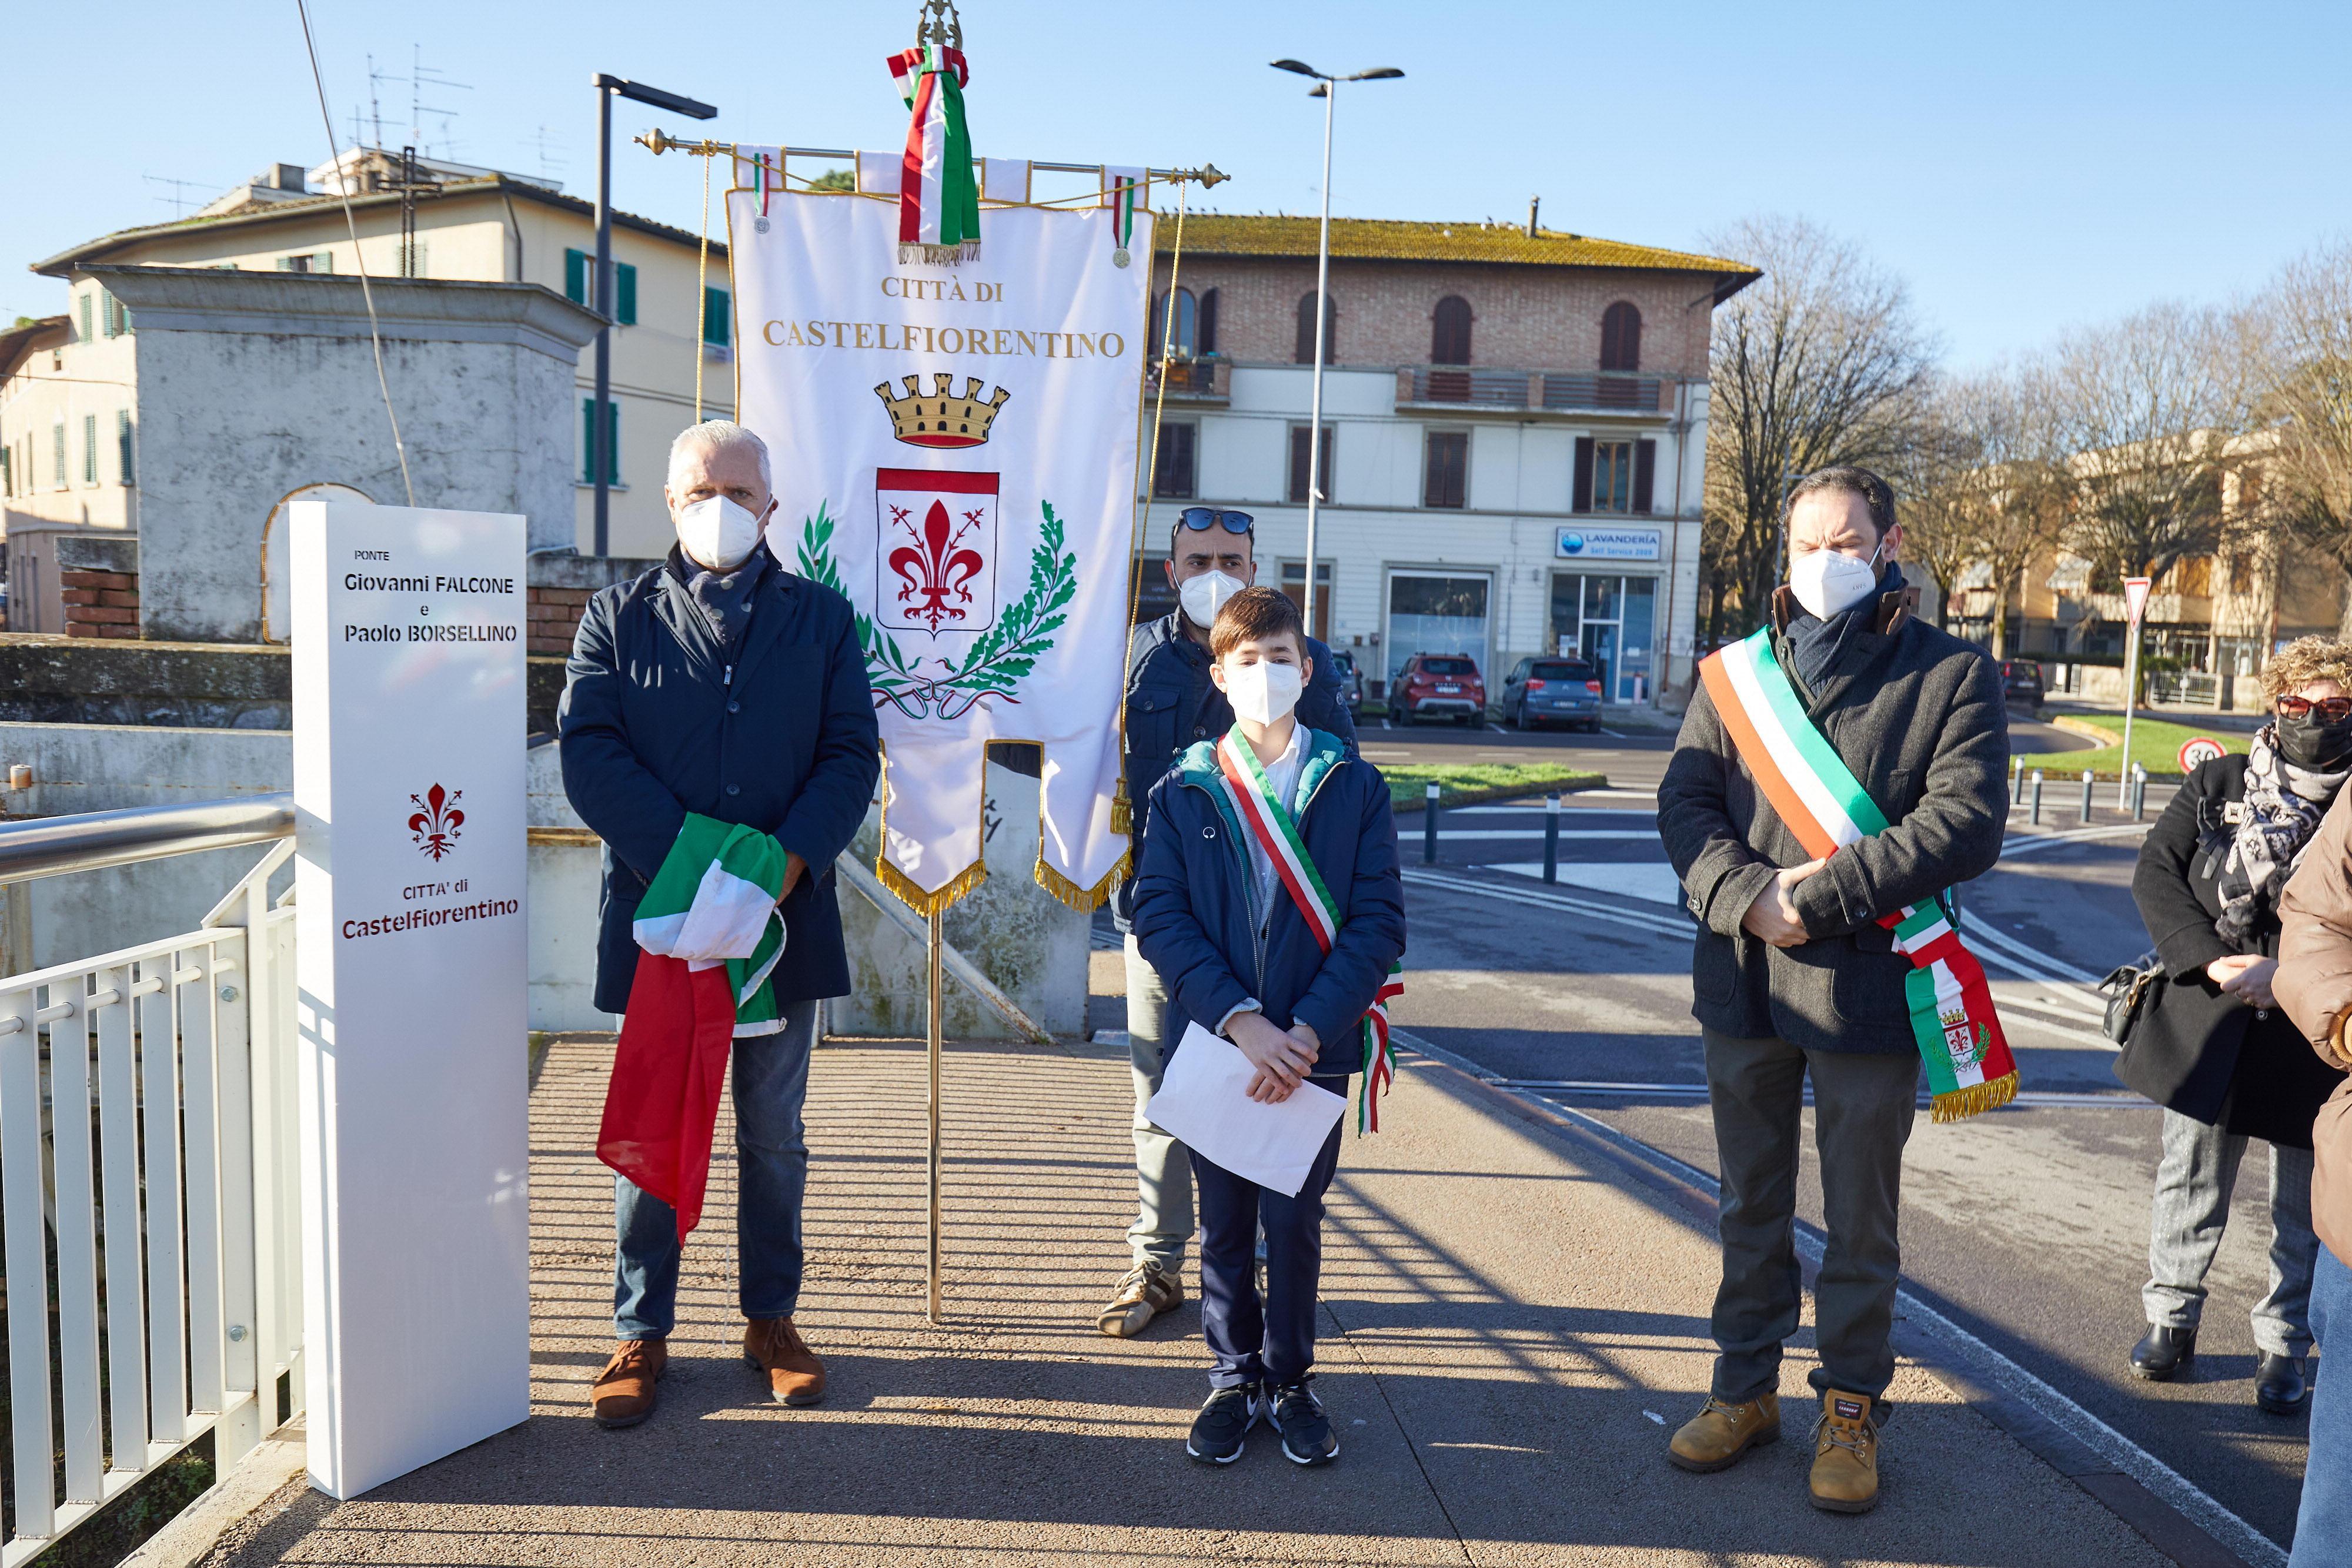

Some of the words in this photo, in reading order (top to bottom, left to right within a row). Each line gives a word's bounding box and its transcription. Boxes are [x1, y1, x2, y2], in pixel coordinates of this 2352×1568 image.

[881, 275, 967, 302] CITTÀ
[974, 282, 1004, 302] DI
[763, 319, 1125, 359] CASTELFIORENTINO
[354, 550, 389, 561] PONTE
[345, 573, 429, 591] Giovanni
[436, 576, 513, 594] FALCONE
[420, 605, 429, 616] e
[345, 624, 401, 642] Paolo
[408, 624, 517, 642] BORSELLINO
[403, 881, 449, 900] CITTA'
[454, 879, 468, 893] di
[342, 899, 518, 940] Castelfiorentino
